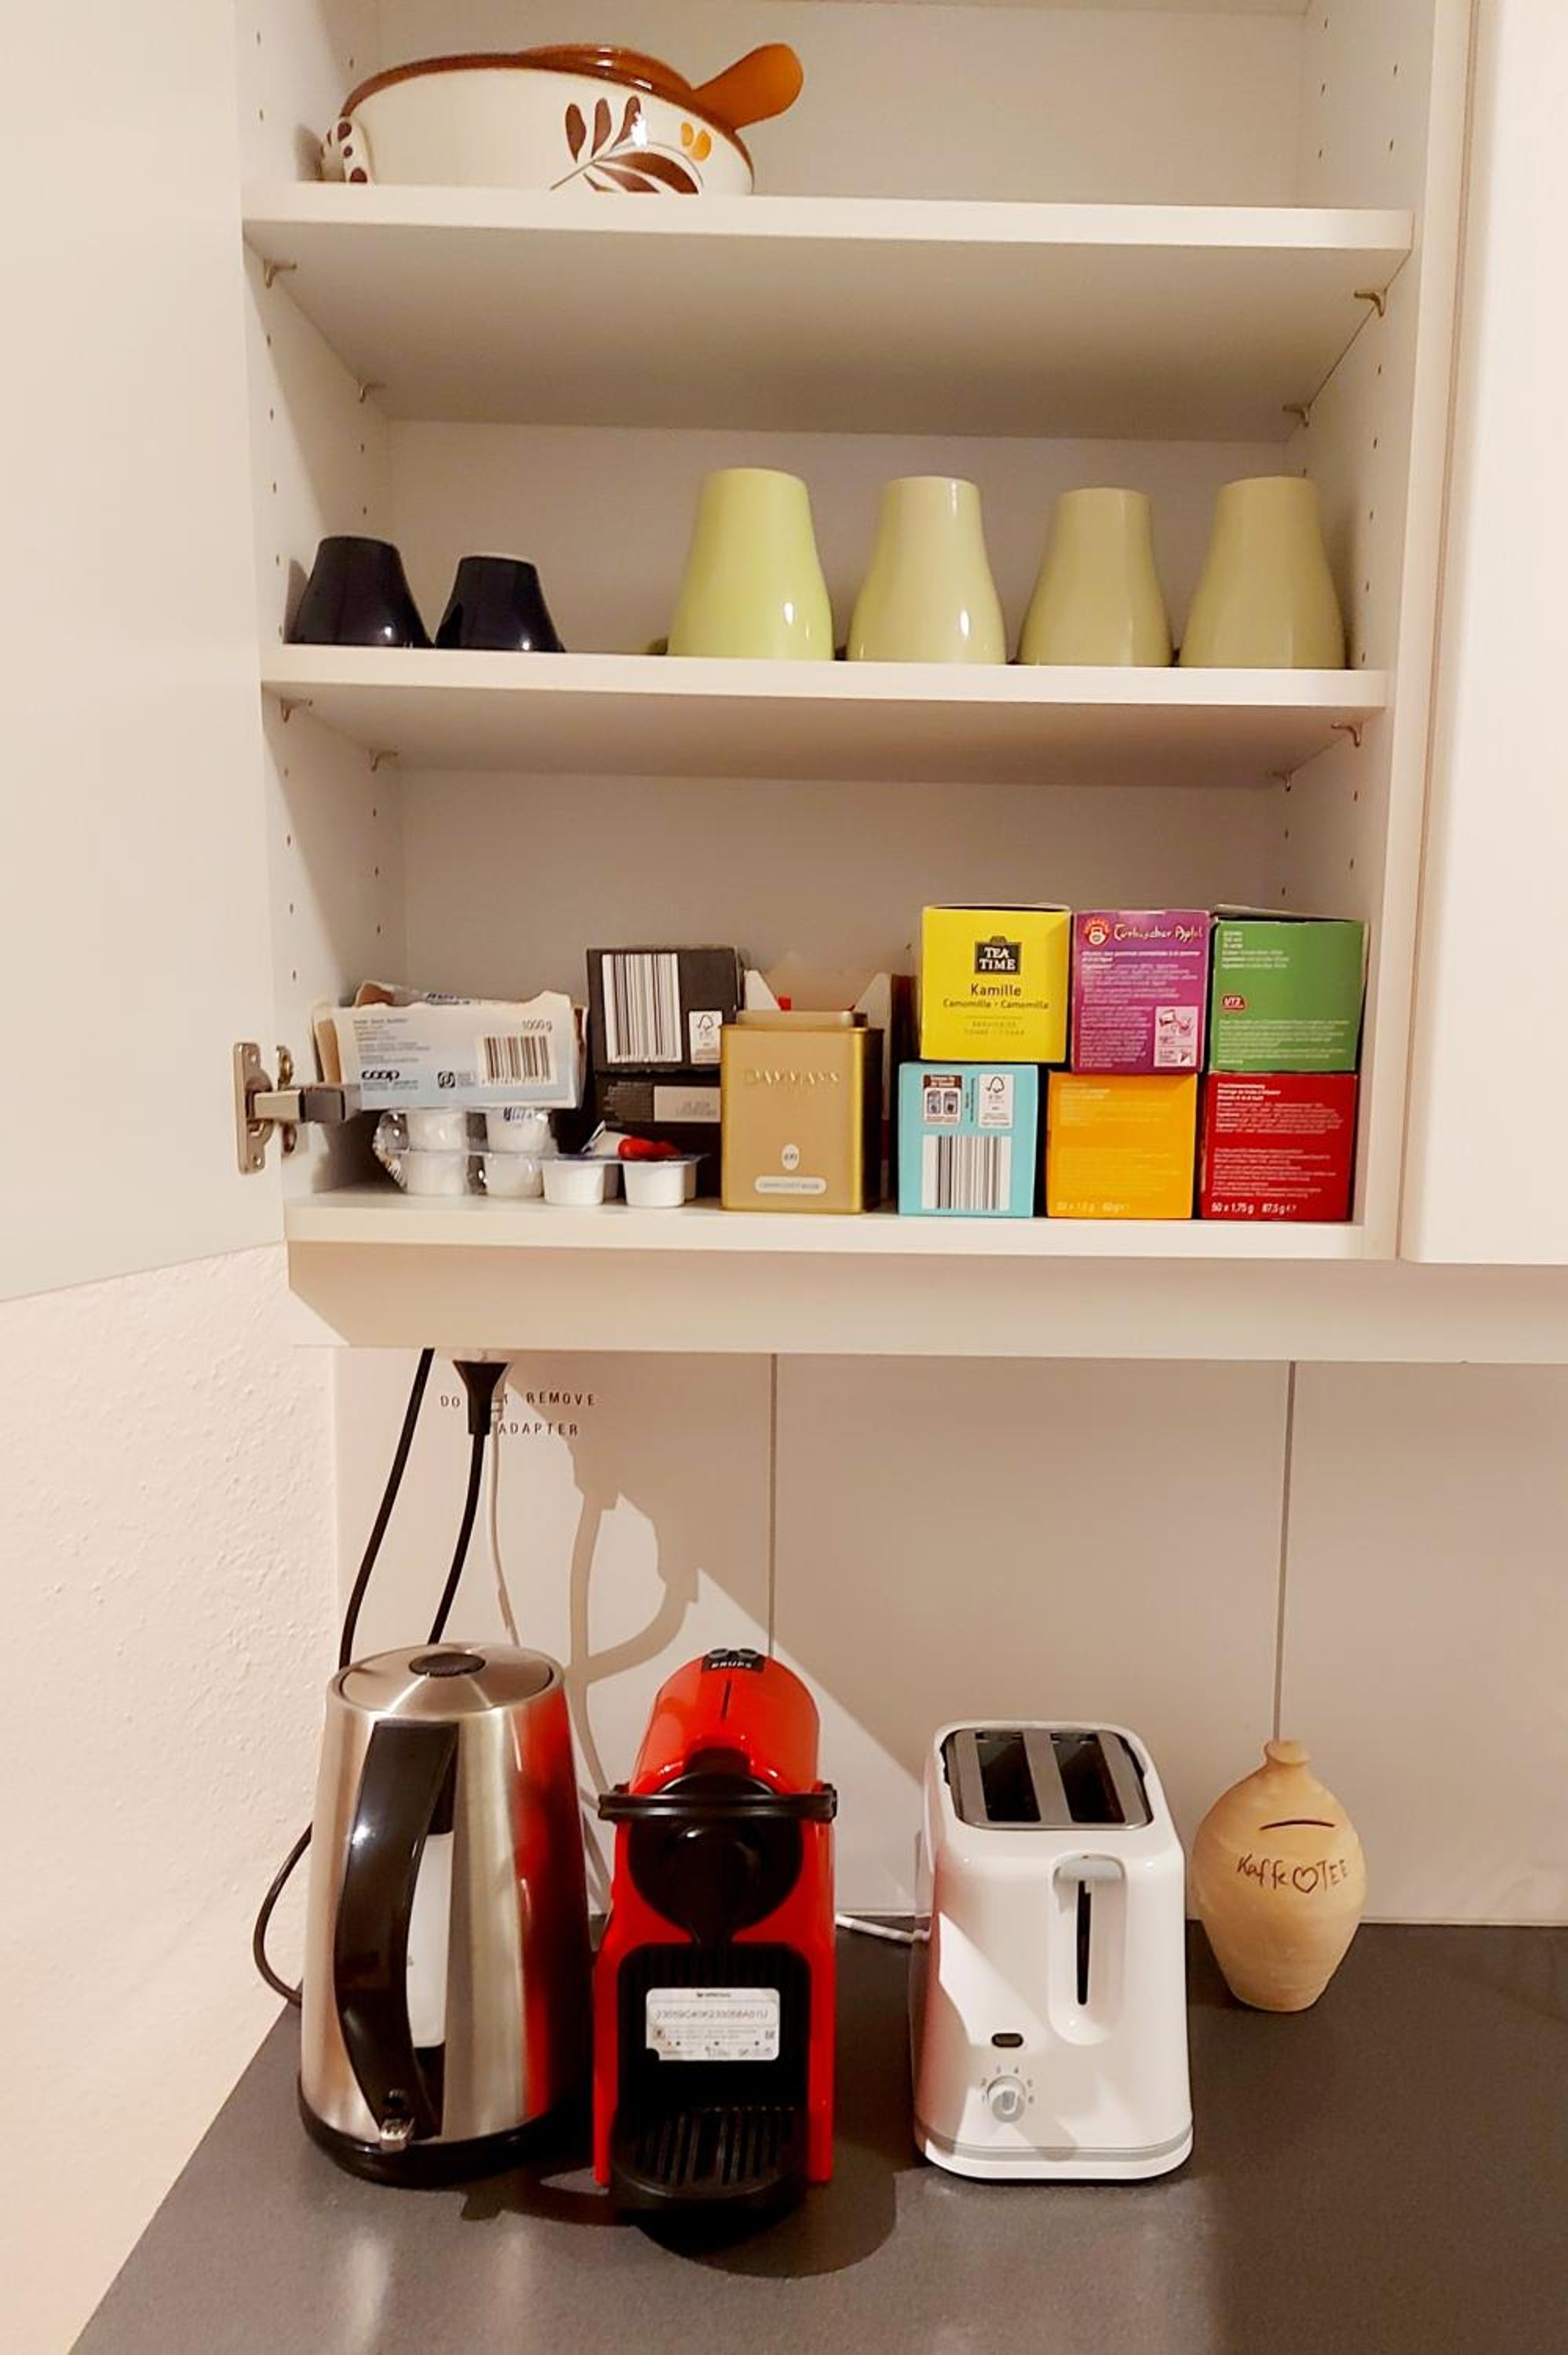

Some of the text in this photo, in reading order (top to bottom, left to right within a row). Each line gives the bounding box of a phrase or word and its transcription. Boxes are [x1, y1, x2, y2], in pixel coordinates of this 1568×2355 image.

[983, 947, 1010, 958] TEA
[979, 958, 1016, 970] TIME
[971, 983, 1022, 996] Kamille
[943, 998, 1049, 1010] Camomille Camomilla
[361, 1070, 401, 1083] coop
[440, 1392, 596, 1408] DO REMOVE
[498, 1422, 578, 1436] ADAPTER
[1316, 1859, 1348, 1891] TEE
